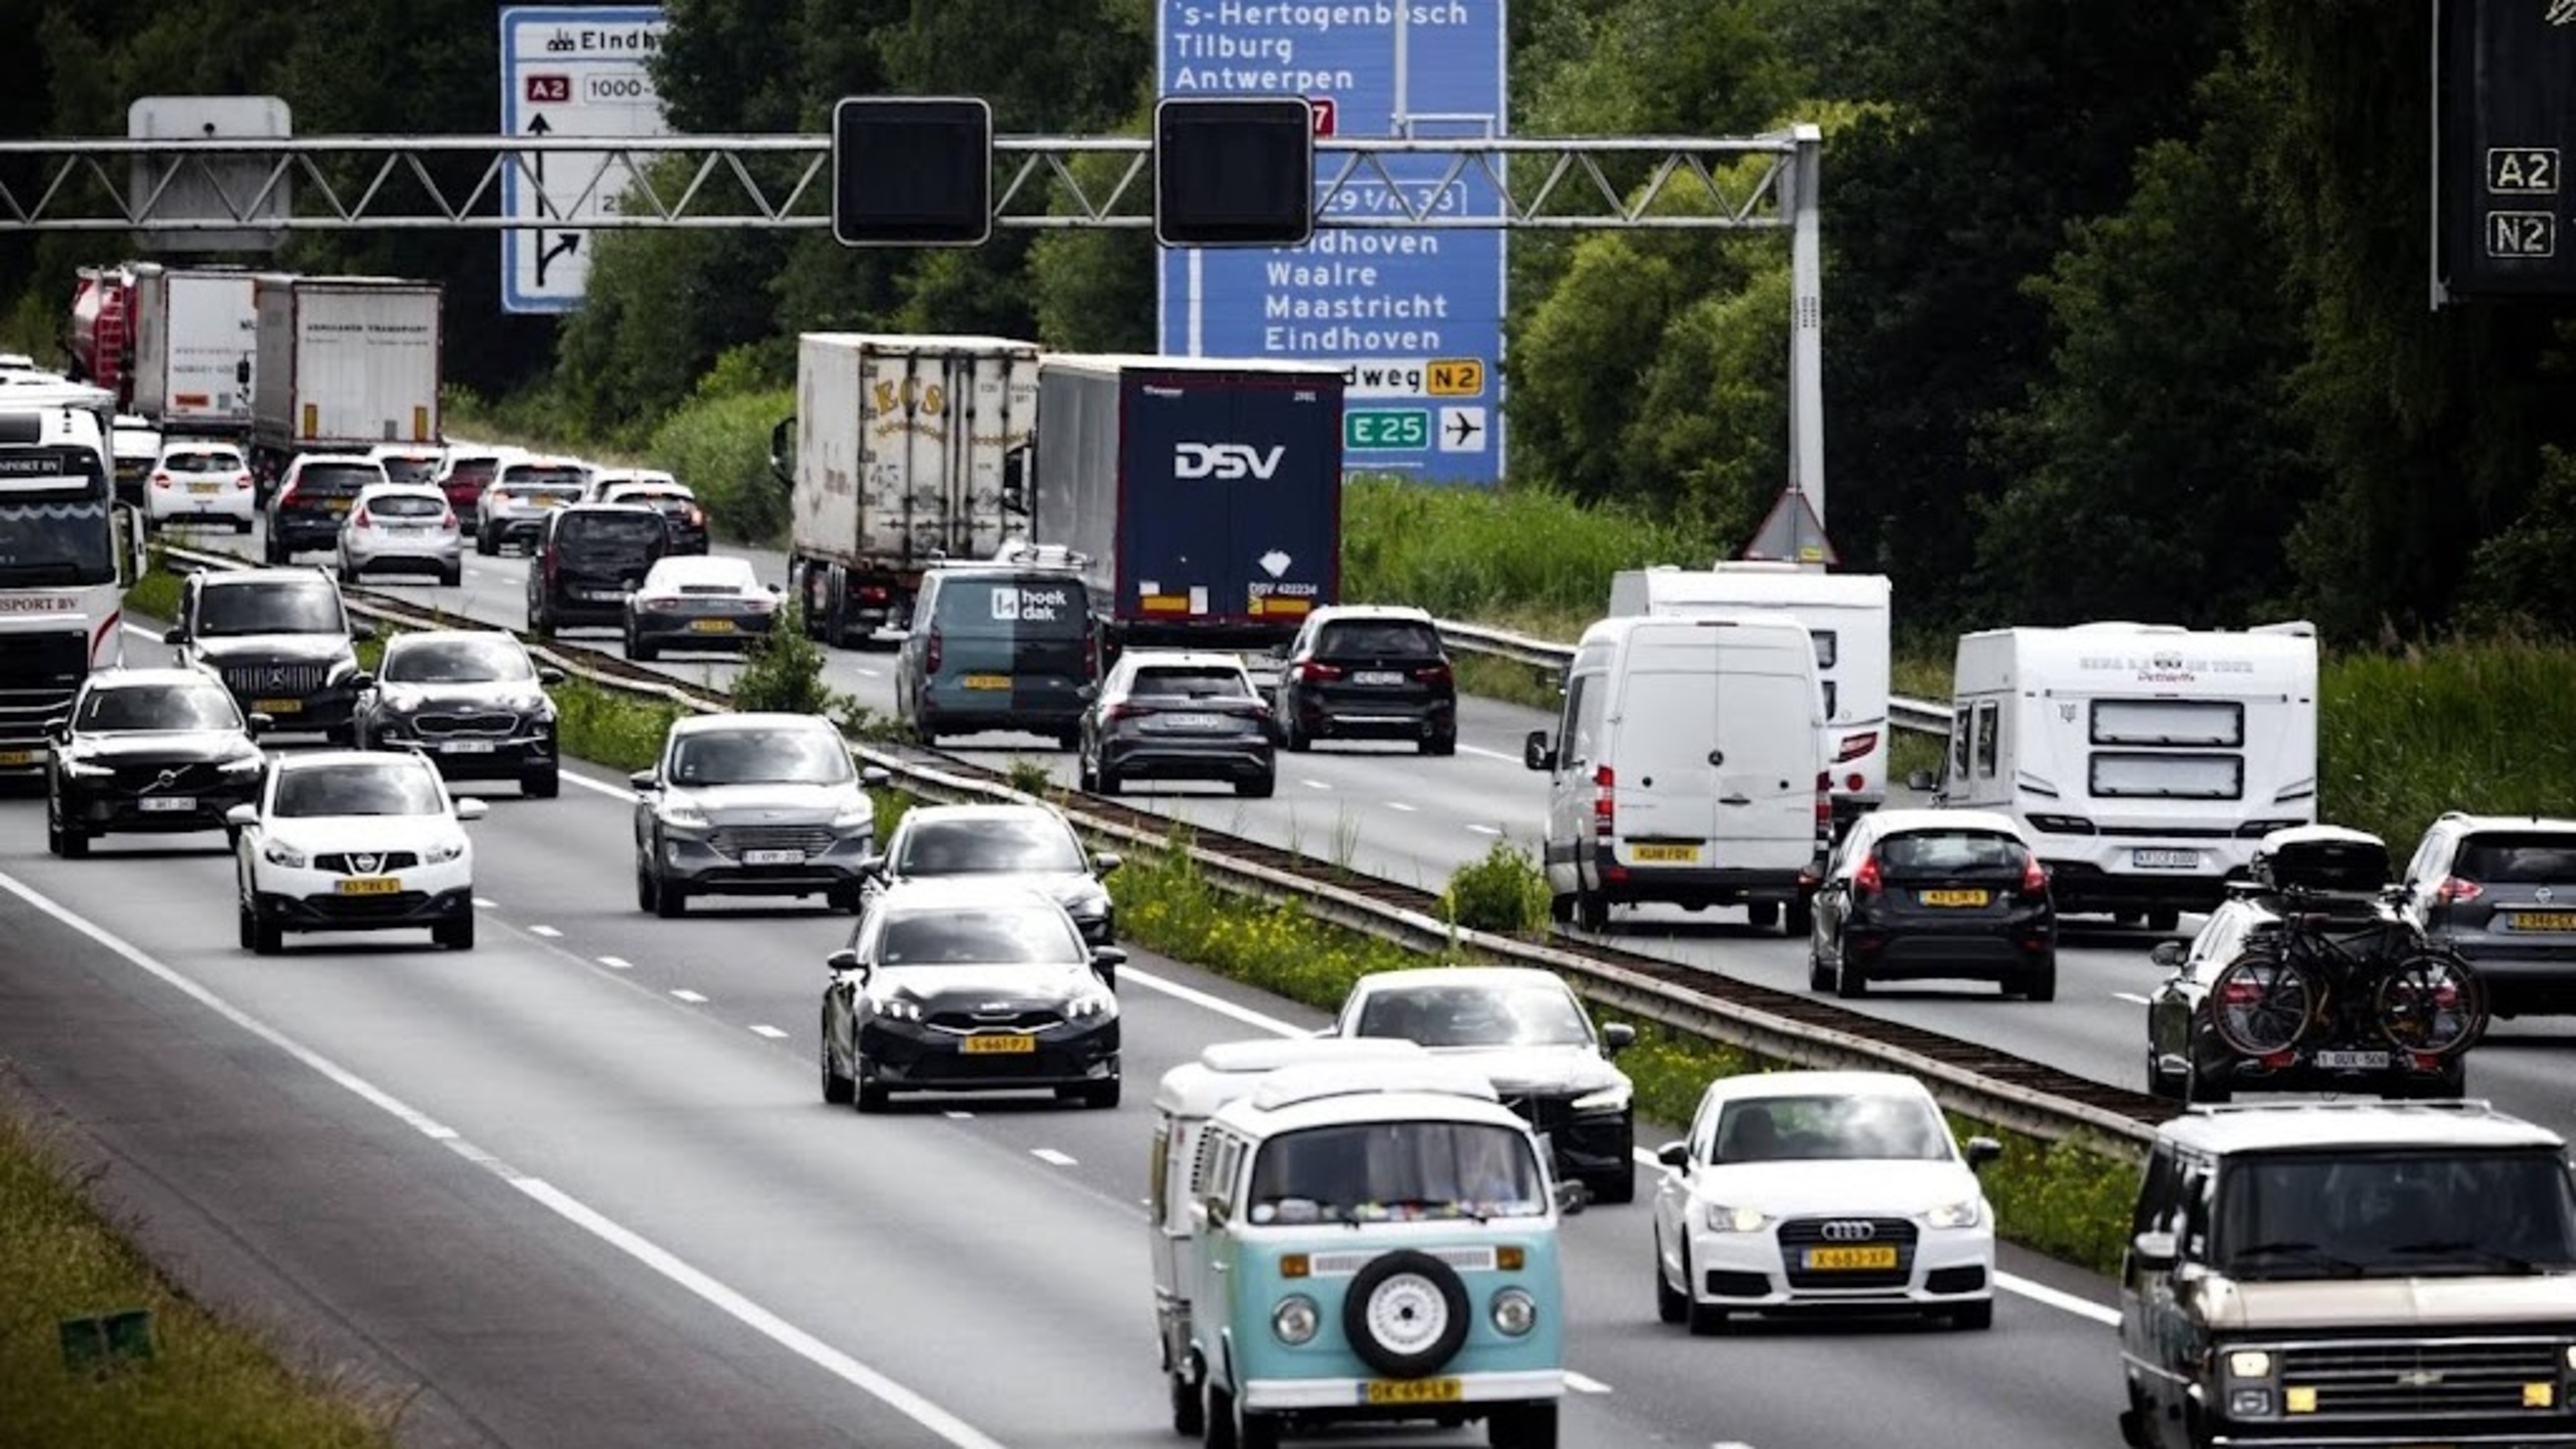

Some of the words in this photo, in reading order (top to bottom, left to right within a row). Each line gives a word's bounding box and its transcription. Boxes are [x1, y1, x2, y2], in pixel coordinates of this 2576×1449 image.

[1175, 2, 1468, 32] 's-Hertogenbsch
[582, 30, 655, 50] Eindh
[1174, 33, 1293, 64] Tilburg
[532, 80, 566, 97] A2
[591, 79, 652, 97] 1000-
[1174, 67, 1354, 95] Antwerpen
[1313, 105, 1328, 130] 7
[2497, 153, 2549, 187] A2
[1273, 229, 1438, 254] ldhoven
[2497, 216, 2544, 252] N2
[1265, 262, 1377, 286] Waalre
[1265, 295, 1448, 319] Maastricht
[1265, 326, 1440, 351] Eindhoven
[1342, 364, 1421, 393] dweg
[1174, 442, 1287, 480] DSV
[1021, 589, 1067, 605] hoek
[1022, 606, 1056, 621] dak
